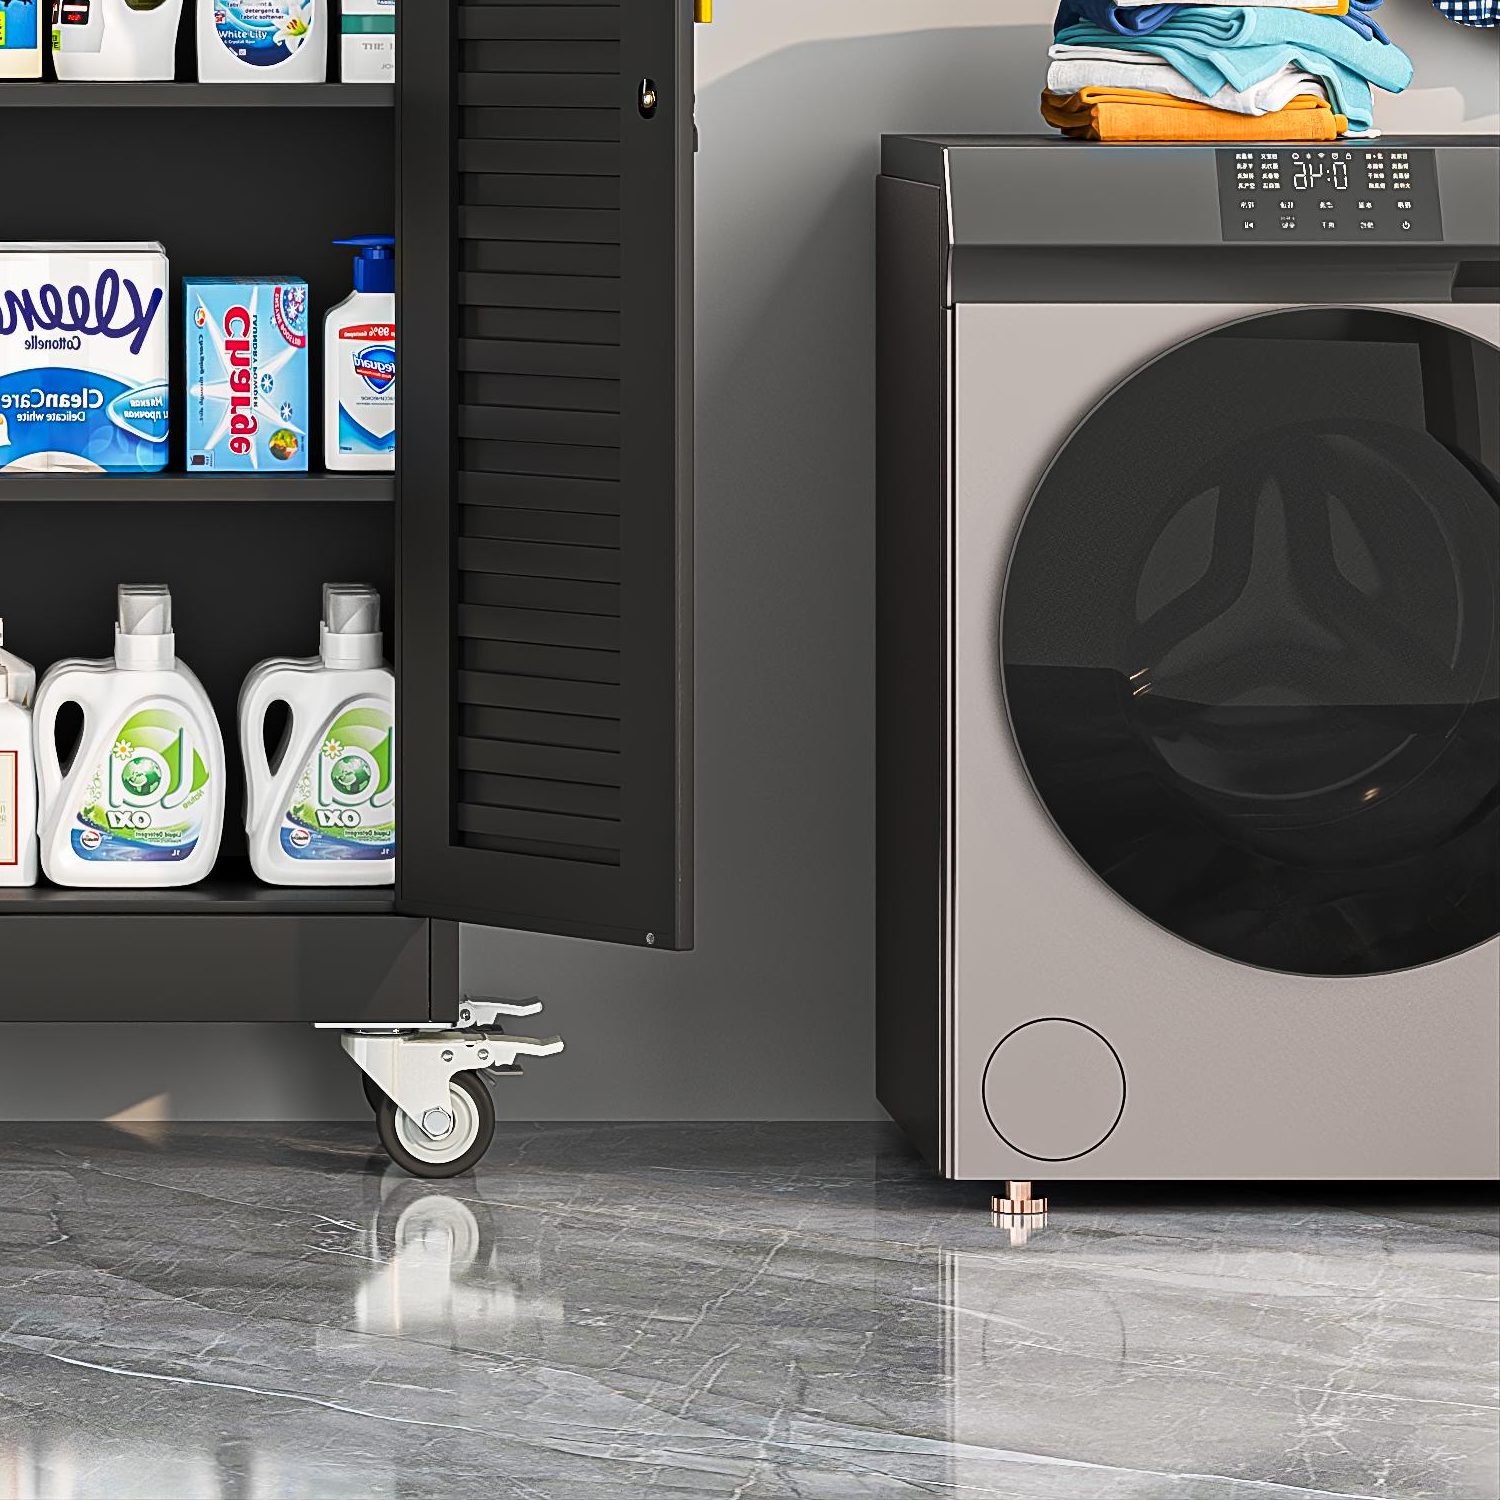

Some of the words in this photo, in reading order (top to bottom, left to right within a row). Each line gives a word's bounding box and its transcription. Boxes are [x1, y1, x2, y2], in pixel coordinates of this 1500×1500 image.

[244, 7, 274, 15] detergent
[220, 30, 247, 39] White
[249, 30, 268, 41] Lily
